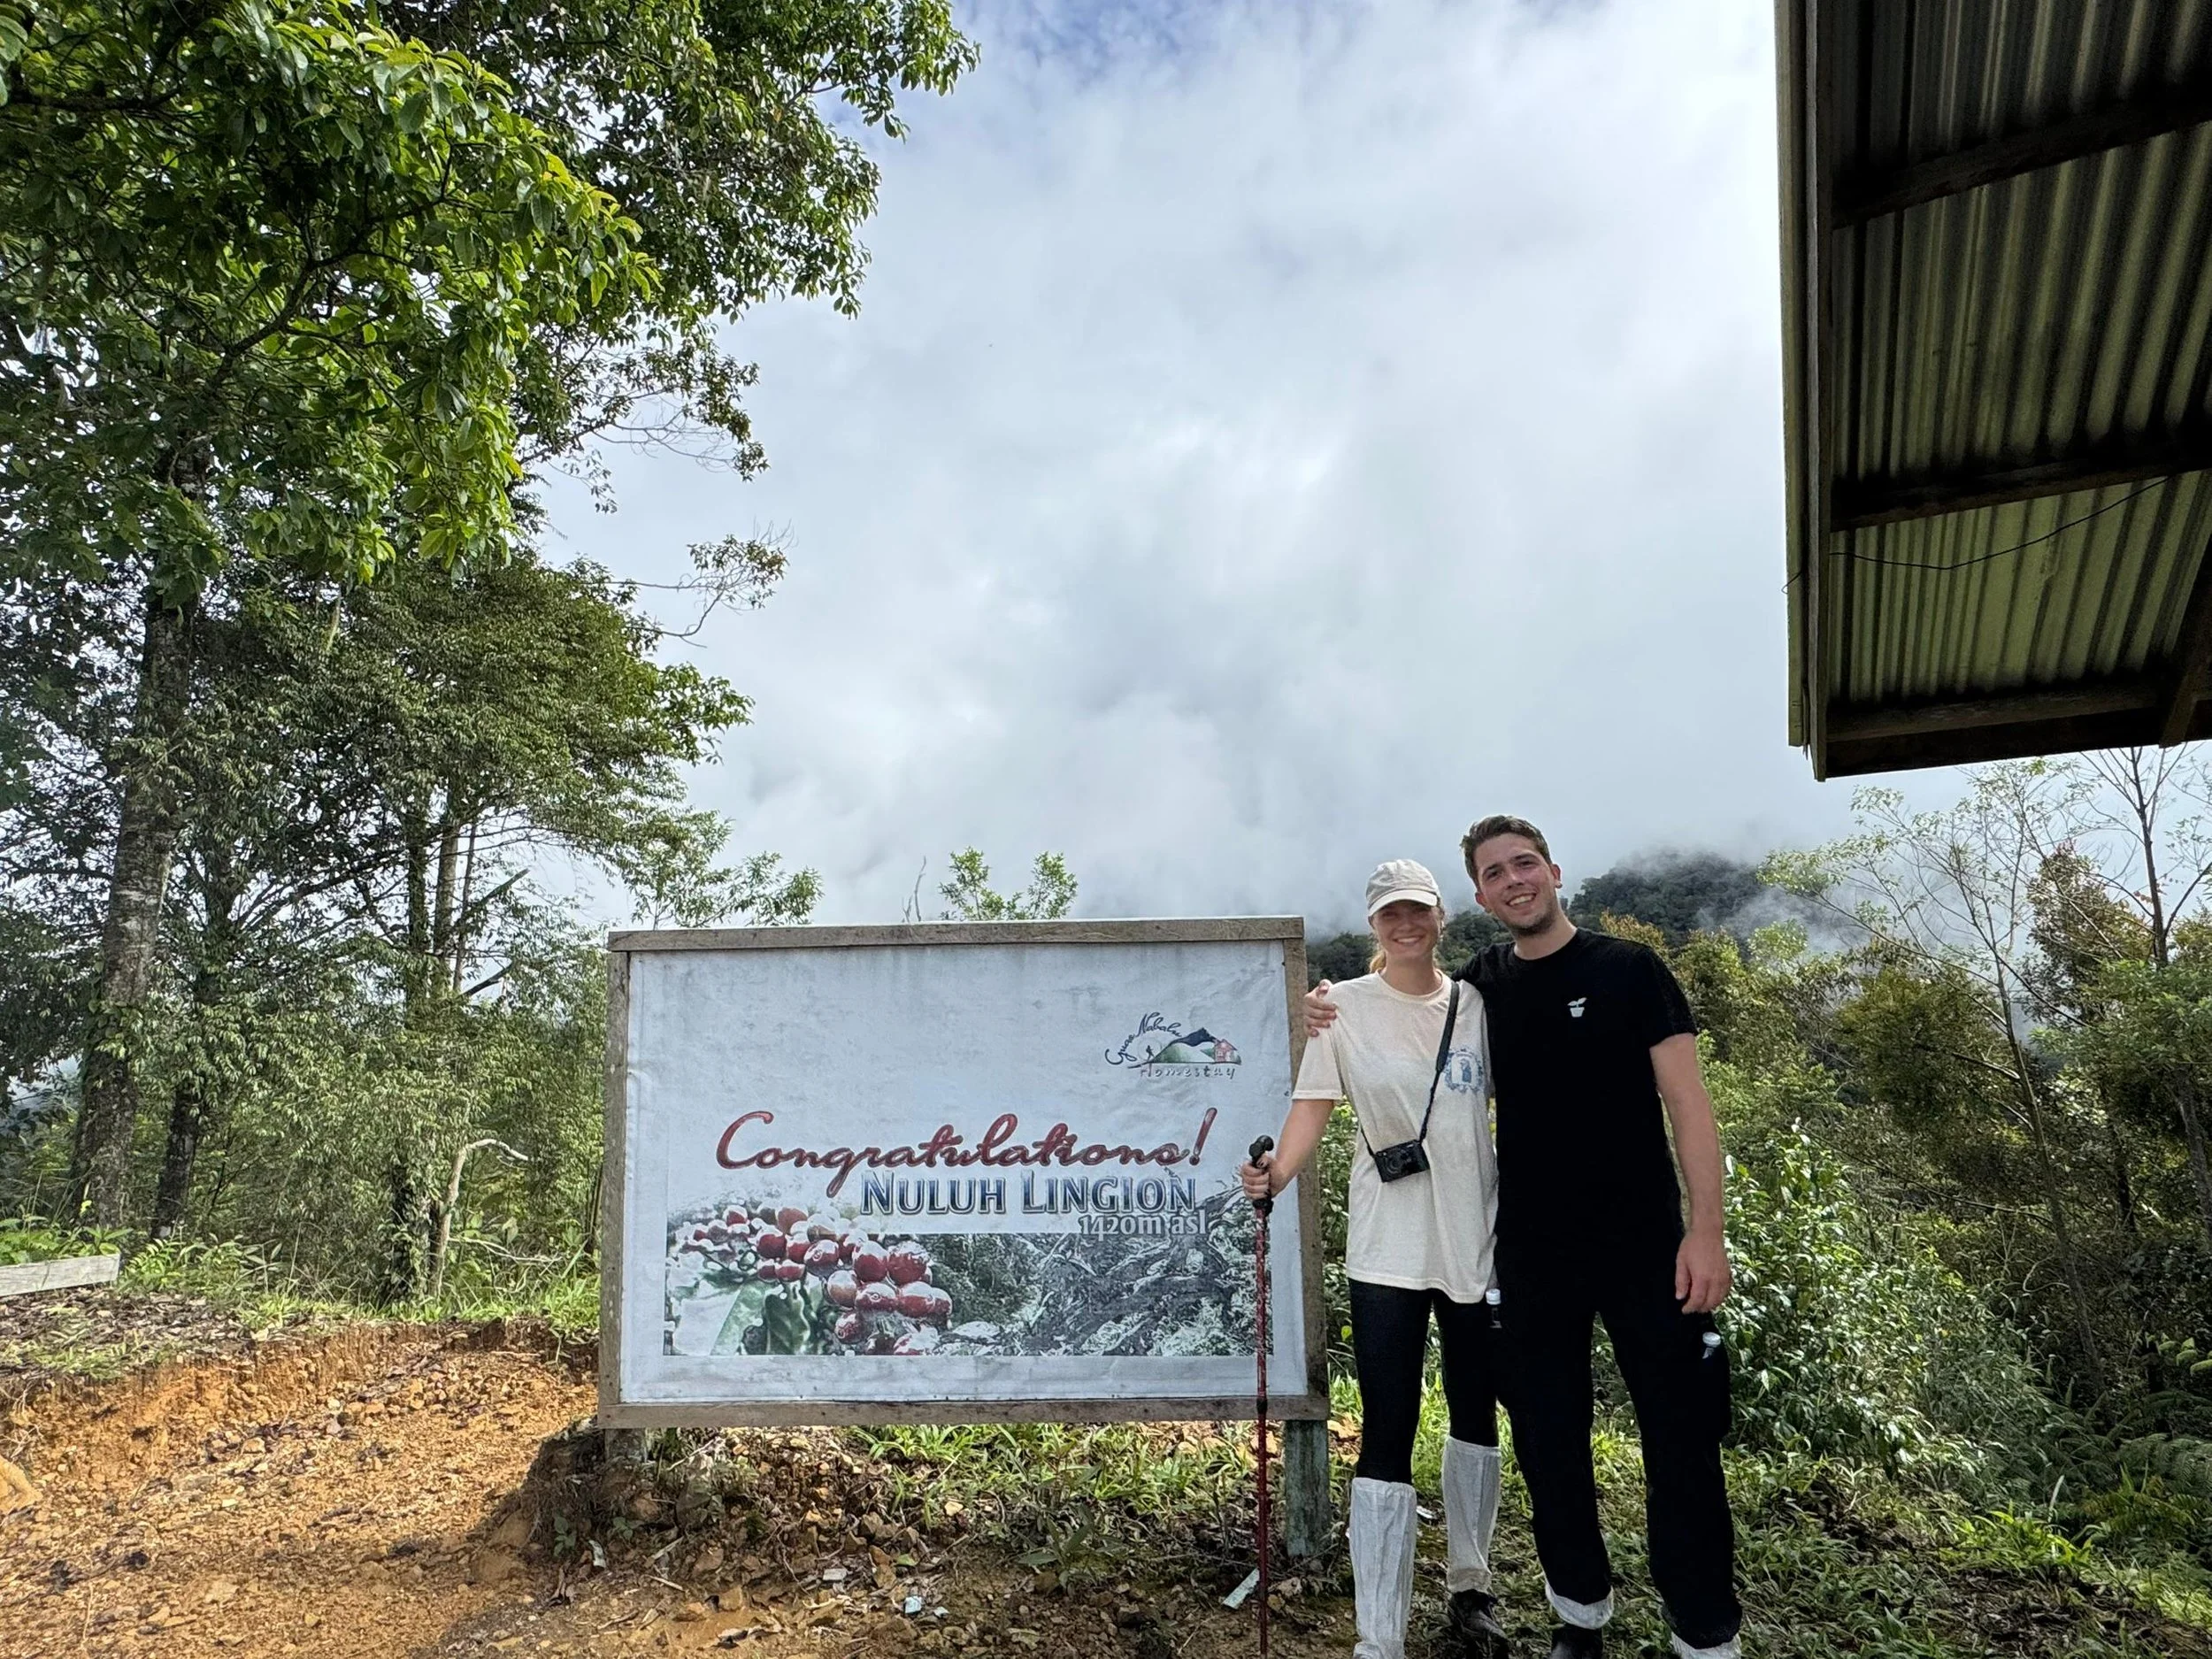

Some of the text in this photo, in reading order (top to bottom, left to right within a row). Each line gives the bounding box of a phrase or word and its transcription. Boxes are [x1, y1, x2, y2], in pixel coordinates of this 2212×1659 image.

[716, 1107, 1218, 1198] Congratulations!
[1079, 1210, 1207, 1241] 1420m asl
